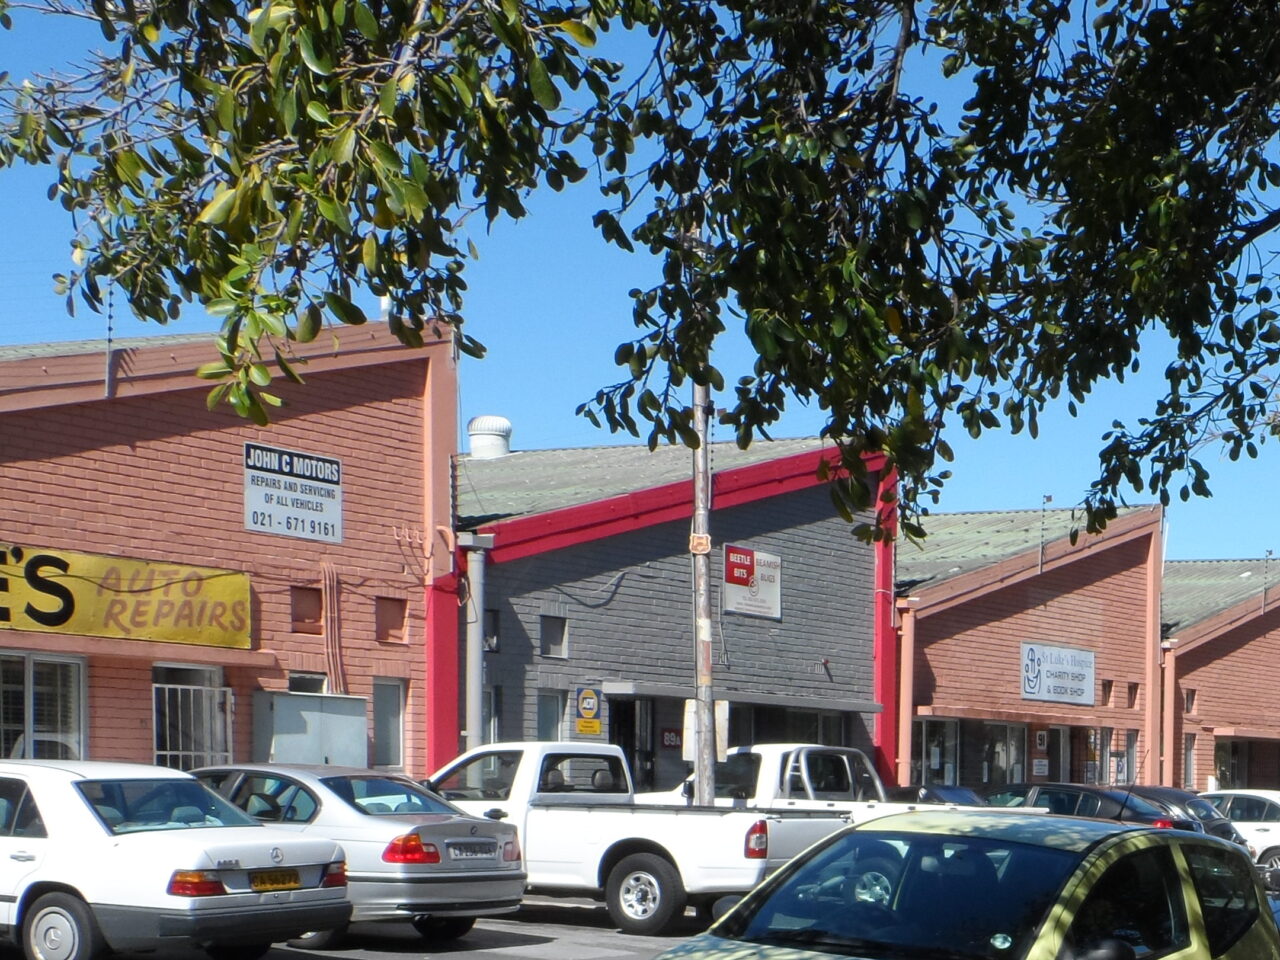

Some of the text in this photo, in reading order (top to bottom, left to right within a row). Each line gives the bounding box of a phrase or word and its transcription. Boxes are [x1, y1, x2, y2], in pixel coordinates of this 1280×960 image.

[247, 448, 339, 481] JOHN C MOTORS
[251, 474, 336, 499] REPAIRS AND SERVICING
[264, 493, 324, 512] OF ALL VEHICLES
[252, 511, 272, 527] 021
[286, 516, 305, 533] 671
[310, 520, 335, 537] 9161
[729, 553, 751, 565] BEETLE
[0, 546, 75, 627] 'S
[97, 566, 203, 597] AUTO
[103, 599, 247, 635] REPAIRS
[1046, 670, 1086, 681] CHARITY SHOP
[1053, 685, 1068, 695] BOOK
[1070, 687, 1084, 696] SHOP
[1038, 734, 1046, 746] 91
